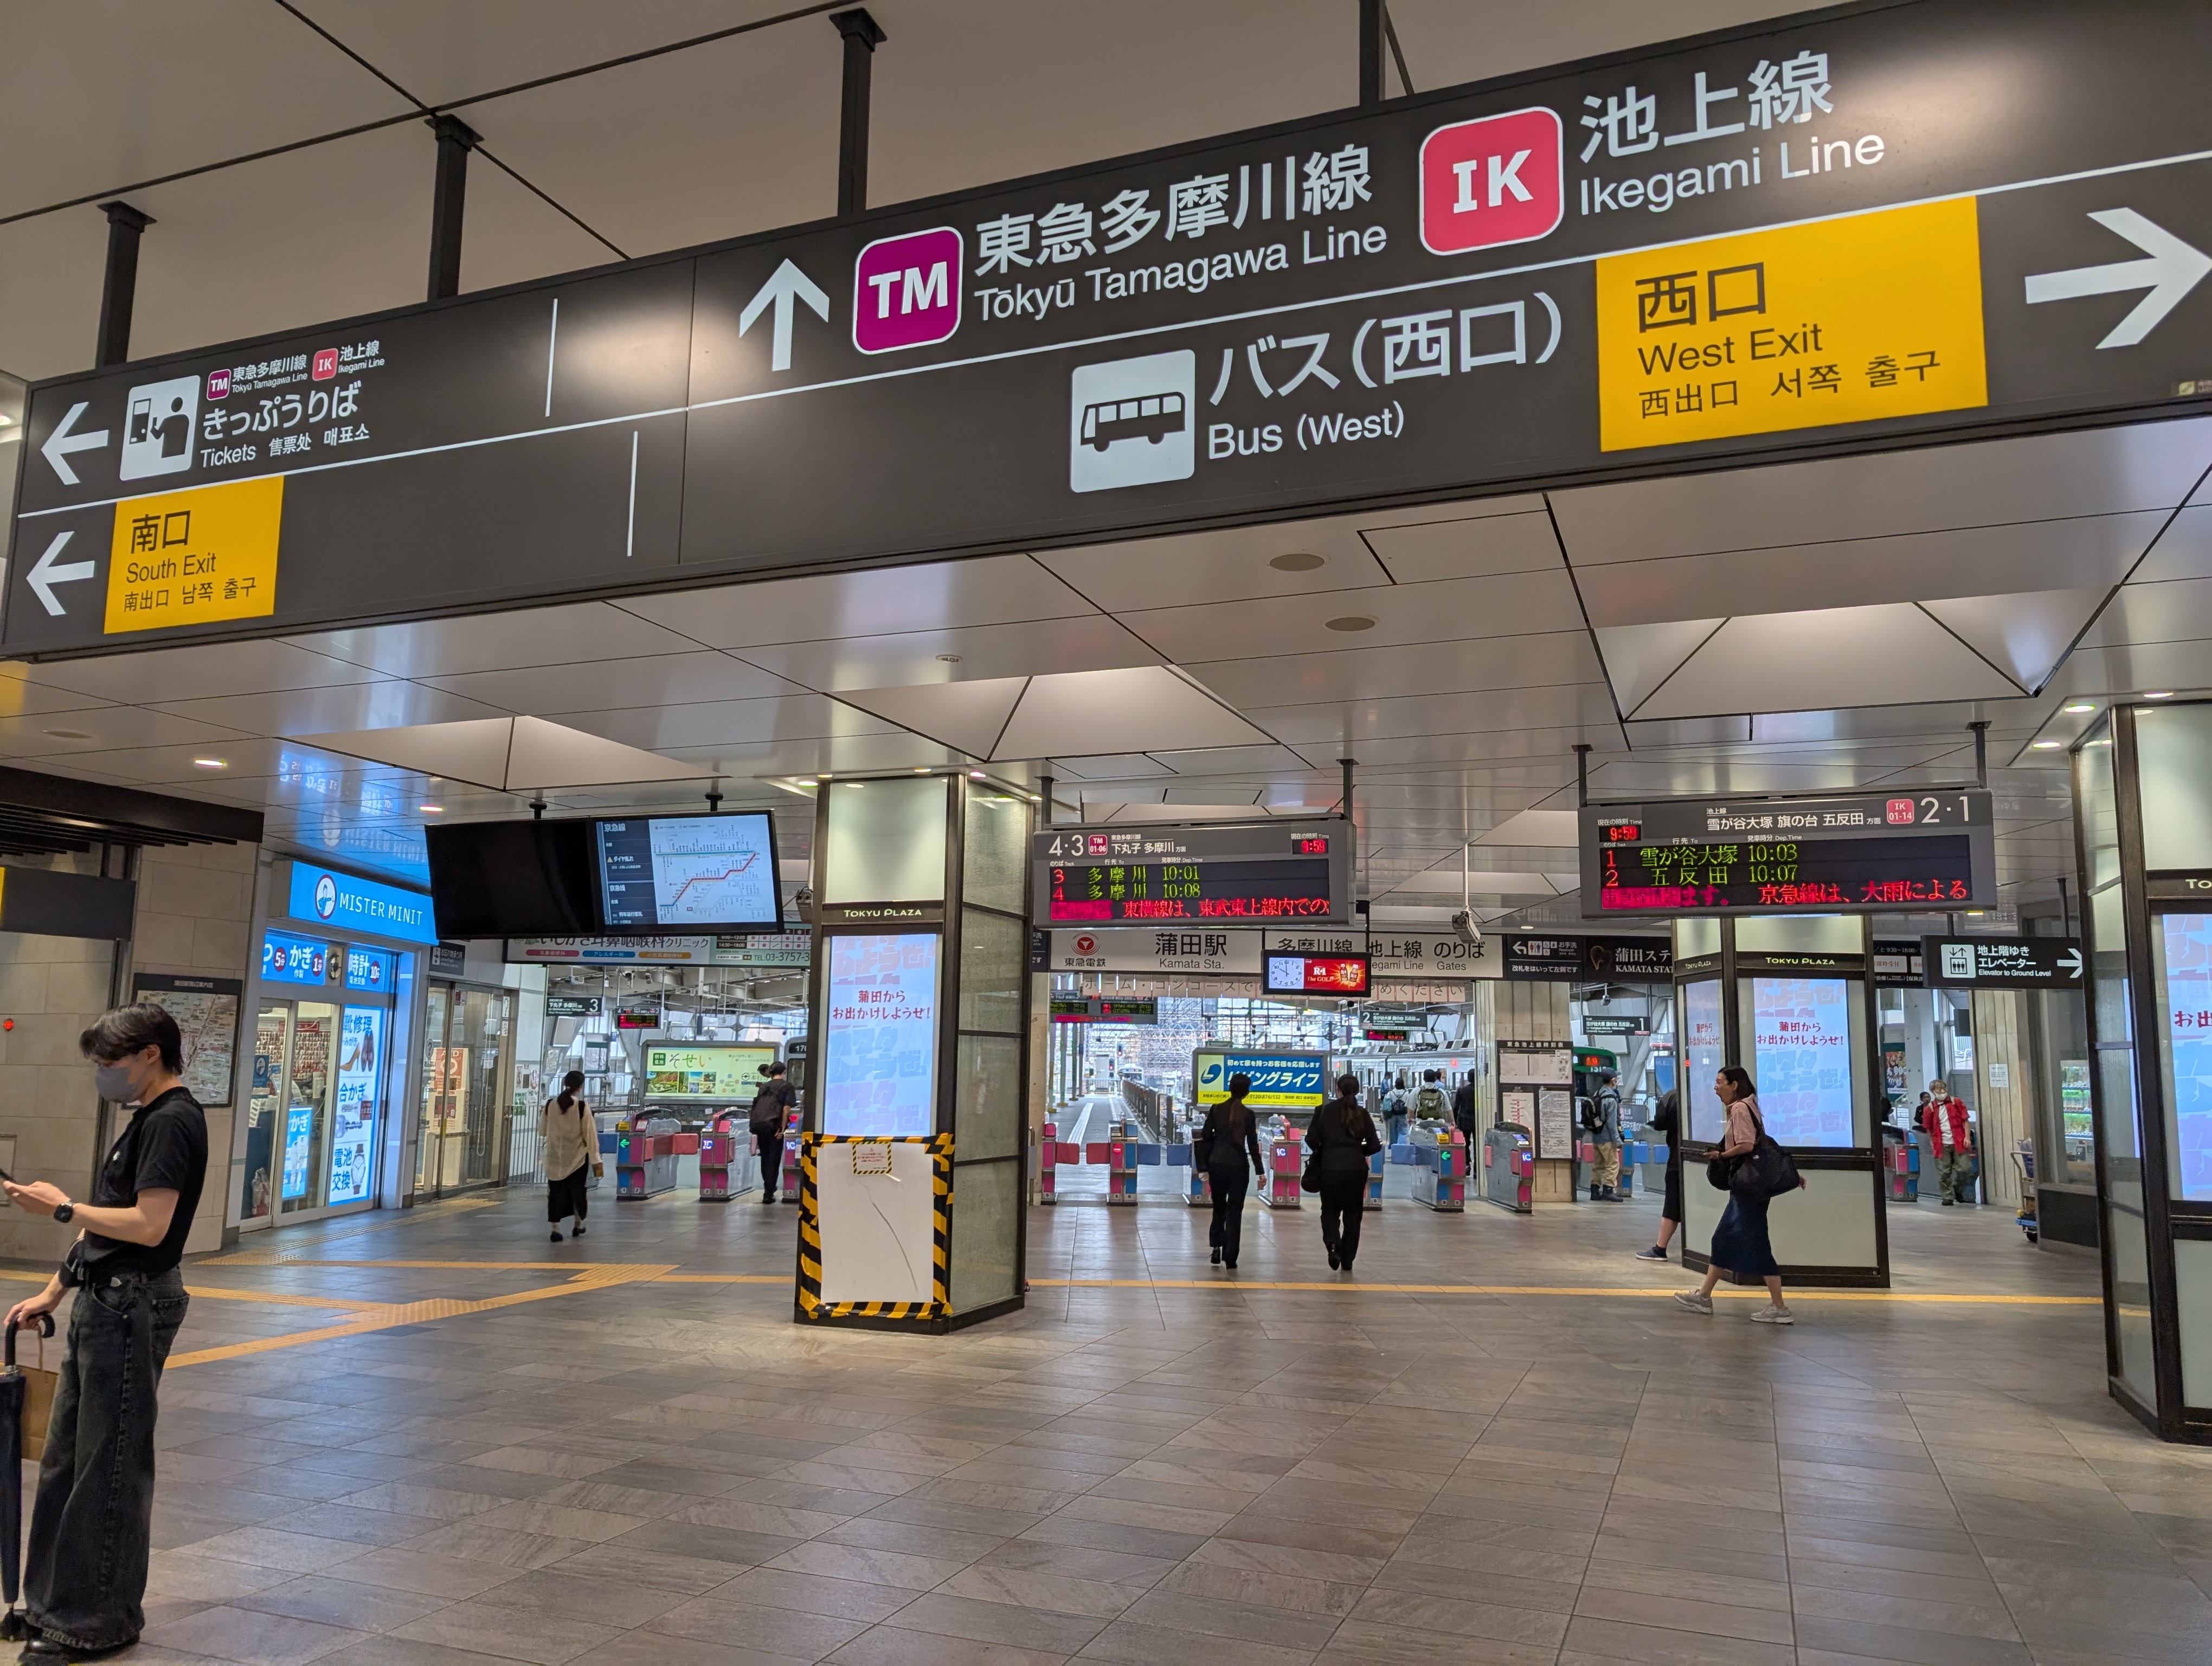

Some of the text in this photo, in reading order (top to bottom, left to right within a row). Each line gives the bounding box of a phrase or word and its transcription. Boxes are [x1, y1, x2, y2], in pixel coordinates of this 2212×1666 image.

[1580, 50, 1835, 163] 池上線
[1452, 149, 1534, 214] IK
[1580, 134, 1886, 215] Ikegami Line
[976, 144, 1373, 278] 東急多摩川線
[974, 225, 1388, 321] Tōkyū Tamagawa Line
[868, 261, 949, 320] TM
[1636, 262, 1766, 332] 西口
[339, 340, 380, 362] 池上線
[1638, 323, 1823, 376] West Exit
[232, 354, 307, 382] 東急多摩川線
[318, 357, 332, 371] IK
[338, 358, 385, 374] Ikegami Line
[211, 378, 228, 392] TM
[254, 376, 291, 390] Tamagawa
[292, 373, 308, 382] Line
[1639, 349, 1940, 420] 西出口 서쪽 출구
[202, 380, 362, 440] きっぷうりば
[269, 423, 370, 457] 售票处 매표소
[1208, 401, 1405, 460] Bus (West)
[201, 443, 256, 469] Tickets
[130, 510, 191, 554] 南口
[126, 552, 216, 584] South Exit
[124, 576, 256, 612] 南出口 남쪽 출구
[1707, 816, 1773, 831] 雪が谷大塚
[1777, 815, 1818, 828] 旗の台
[1822, 813, 1863, 826] 五反田
[1889, 812, 1912, 821] 01-14
[604, 823, 626, 832] 京急線
[1610, 826, 1637, 841] 9:59
[1113, 843, 1141, 855] 下丸子
[1144, 842, 1174, 854] 多摩川
[1606, 844, 1797, 867] 1 雪が谷大塚 10:03
[1053, 866, 1200, 883] 3 多摩川 10:01
[1606, 864, 1798, 887] 2 五反田 10:07
[1053, 883, 1200, 900] 4 多摩川 10:08
[339, 892, 422, 926] MISTER MINIT
[1155, 933, 1227, 957] 蒲田駅
[1434, 941, 1486, 958] のりば
[1978, 945, 2029, 956] 地上階ゆき
[289, 945, 314, 969] かぎ
[348, 953, 370, 977] 時計
[1065, 958, 1106, 967] 東急電鉄
[1159, 958, 1225, 969] Kamata Sta.
[1404, 961, 1424, 970] Line
[1437, 962, 1467, 971] Gates
[1979, 958, 2036, 968] エレベーター
[1512, 965, 1578, 973] 改札をはいって左側です
[589, 998, 598, 1013] 3
[859, 990, 905, 1003] 蒲田から
[1362, 1012, 1371, 1023] 2
[1639, 1018, 1644, 1031] 1
[1779, 1021, 1821, 1032] 蒲田から
[669, 1053, 711, 1068] そせい
[339, 1082, 367, 1102] 合かぎ
[703, 1140, 713, 1149] IC
[787, 1142, 795, 1150] IC
[335, 1146, 352, 1167] 電池
[332, 1171, 350, 1192] 交換
